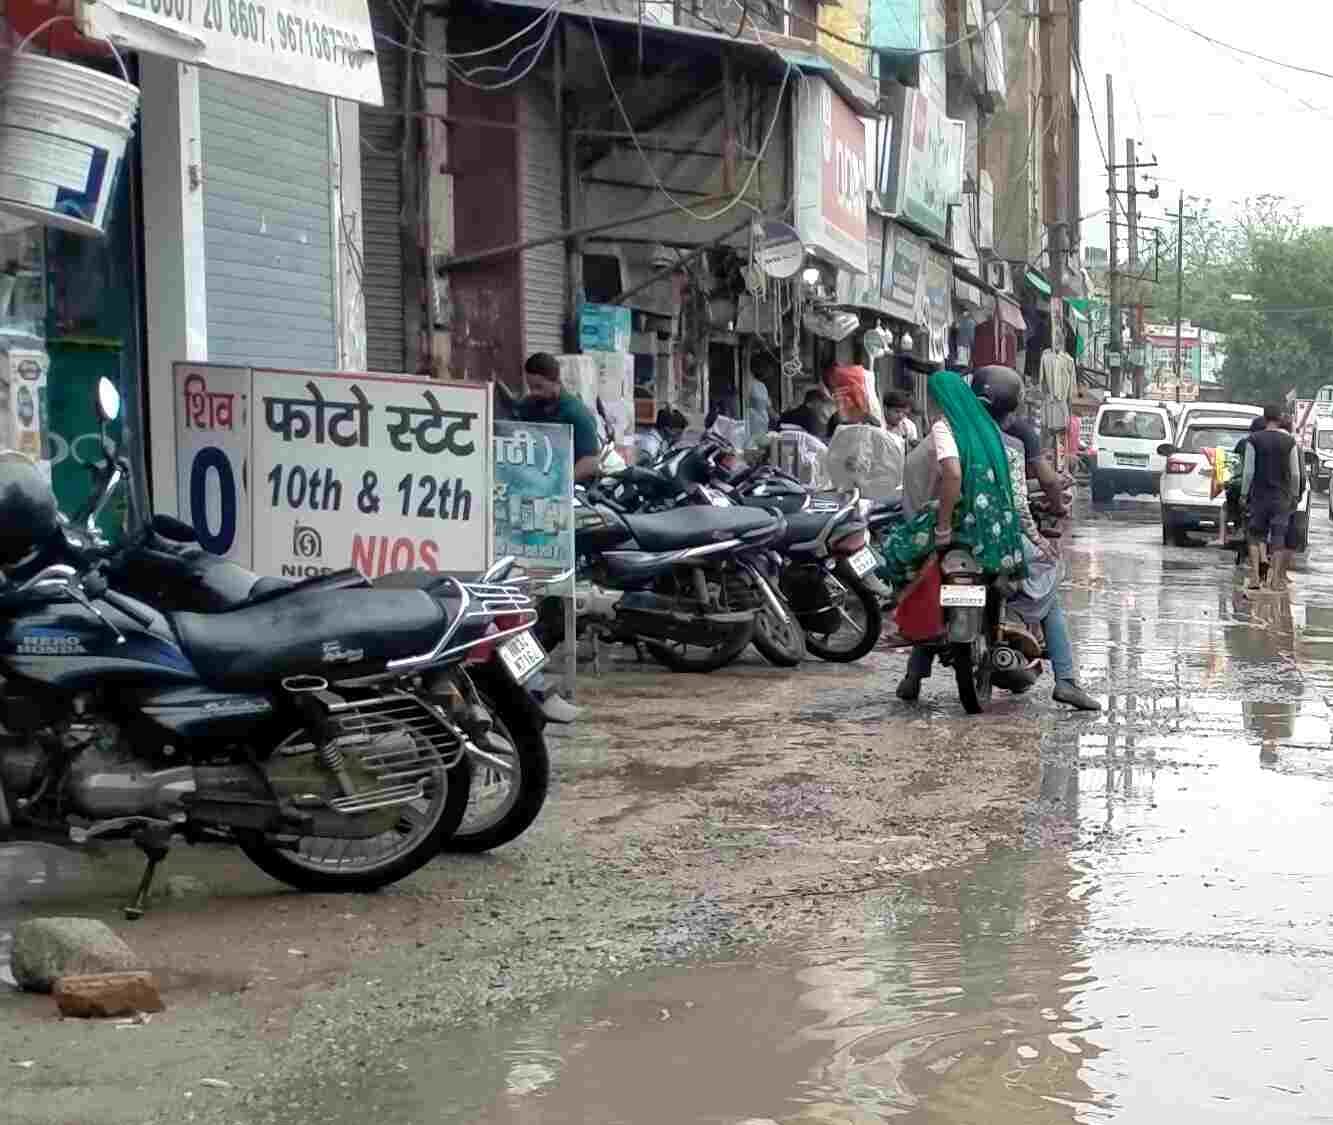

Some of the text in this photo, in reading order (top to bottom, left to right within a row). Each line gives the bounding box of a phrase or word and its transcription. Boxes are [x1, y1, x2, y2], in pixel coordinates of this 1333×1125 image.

[184, 373, 235, 430] शिव
[263, 381, 479, 457] फोटो स्टेट
[267, 463, 343, 512] 10th
[357, 470, 381, 514] &
[398, 472, 473, 521] 12th
[17, 644, 88, 654] HONDA
[24, 635, 80, 645] HERO
